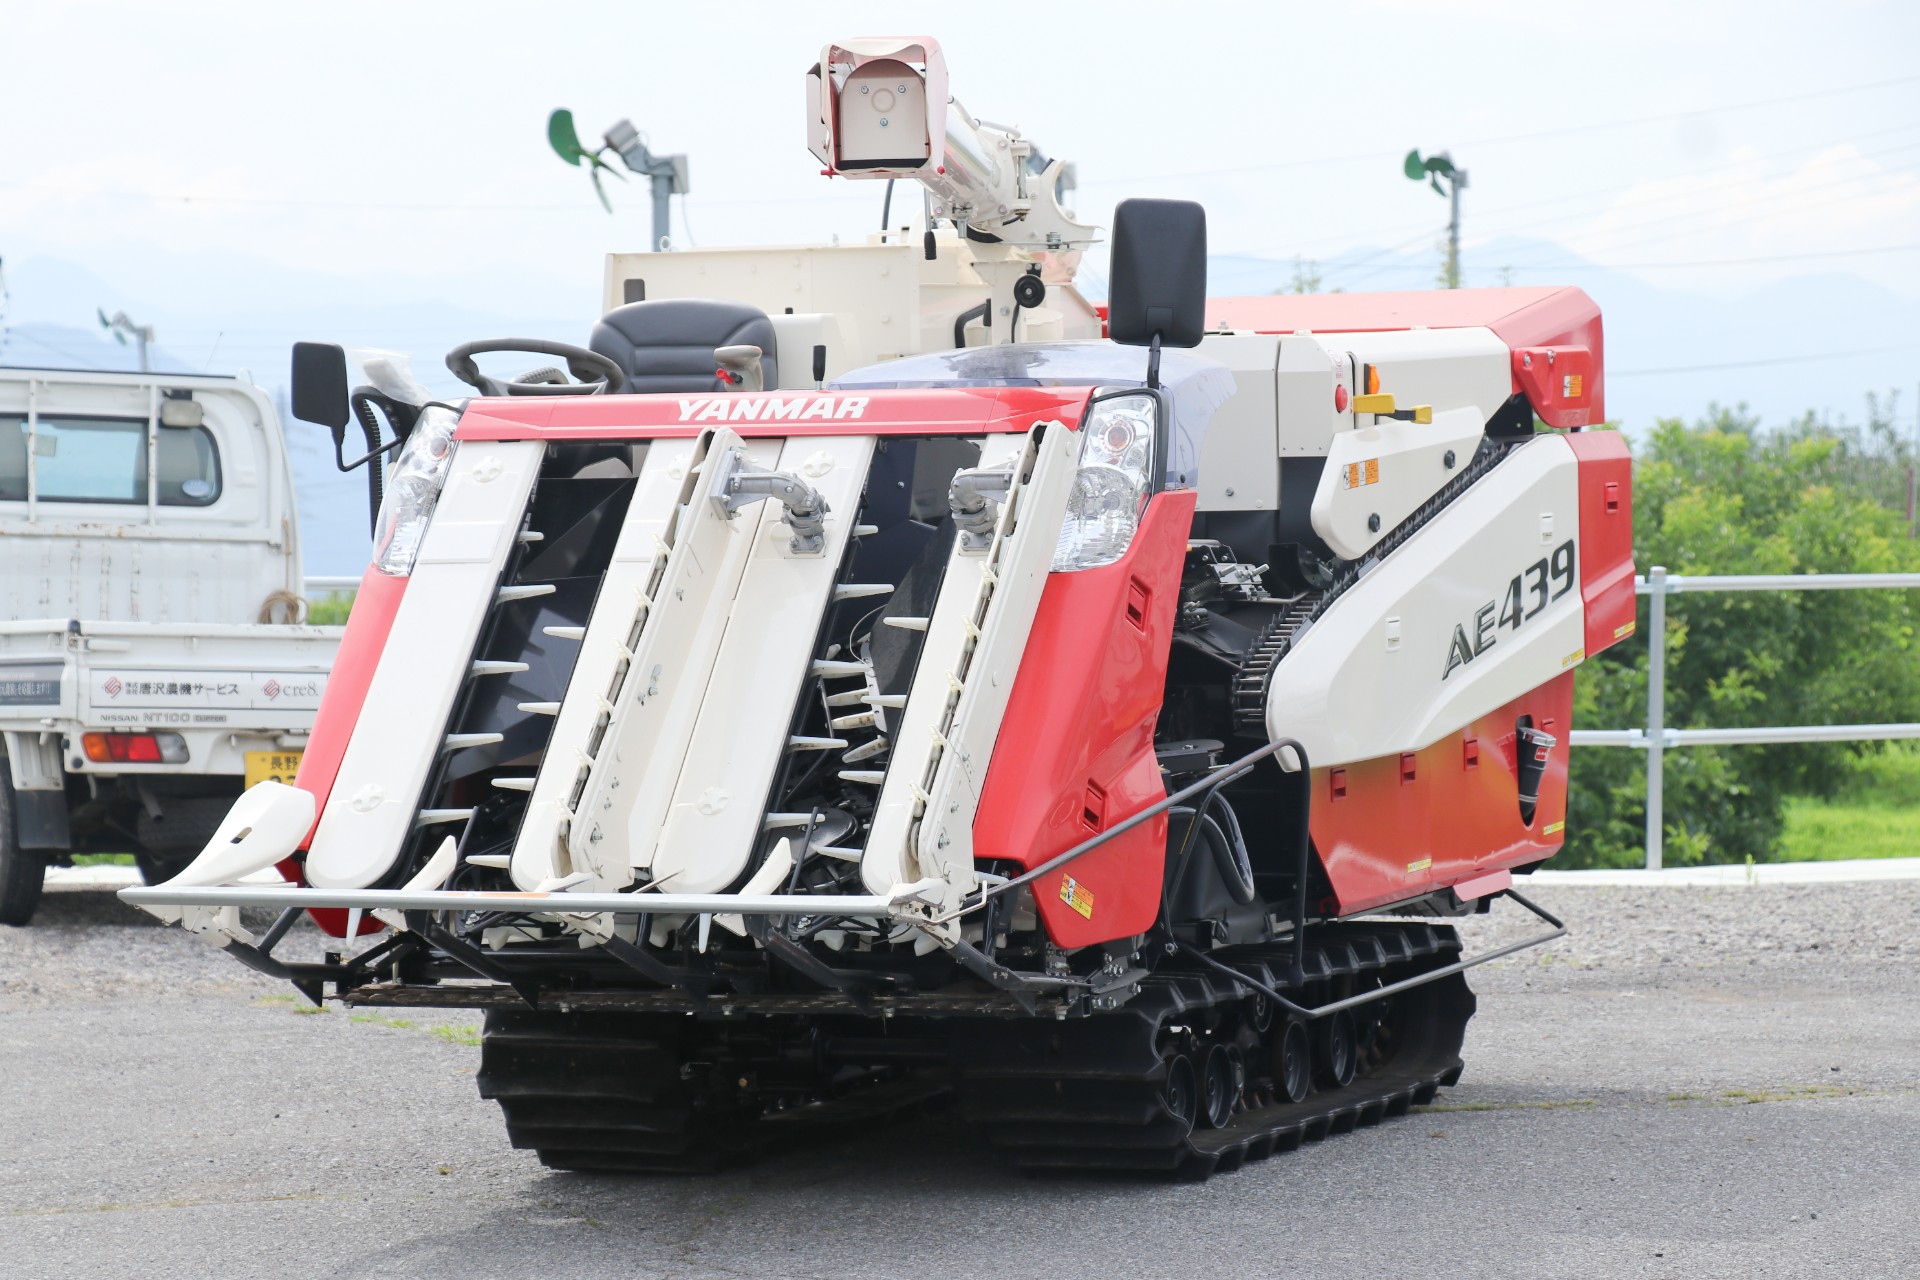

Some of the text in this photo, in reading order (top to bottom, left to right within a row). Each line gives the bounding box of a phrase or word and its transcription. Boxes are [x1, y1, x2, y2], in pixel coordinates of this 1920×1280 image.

[678, 397, 870, 421] YANMAR
[1442, 538, 1576, 681] AE439
[143, 712, 190, 723] NT100
[270, 756, 297, 771] 長野
